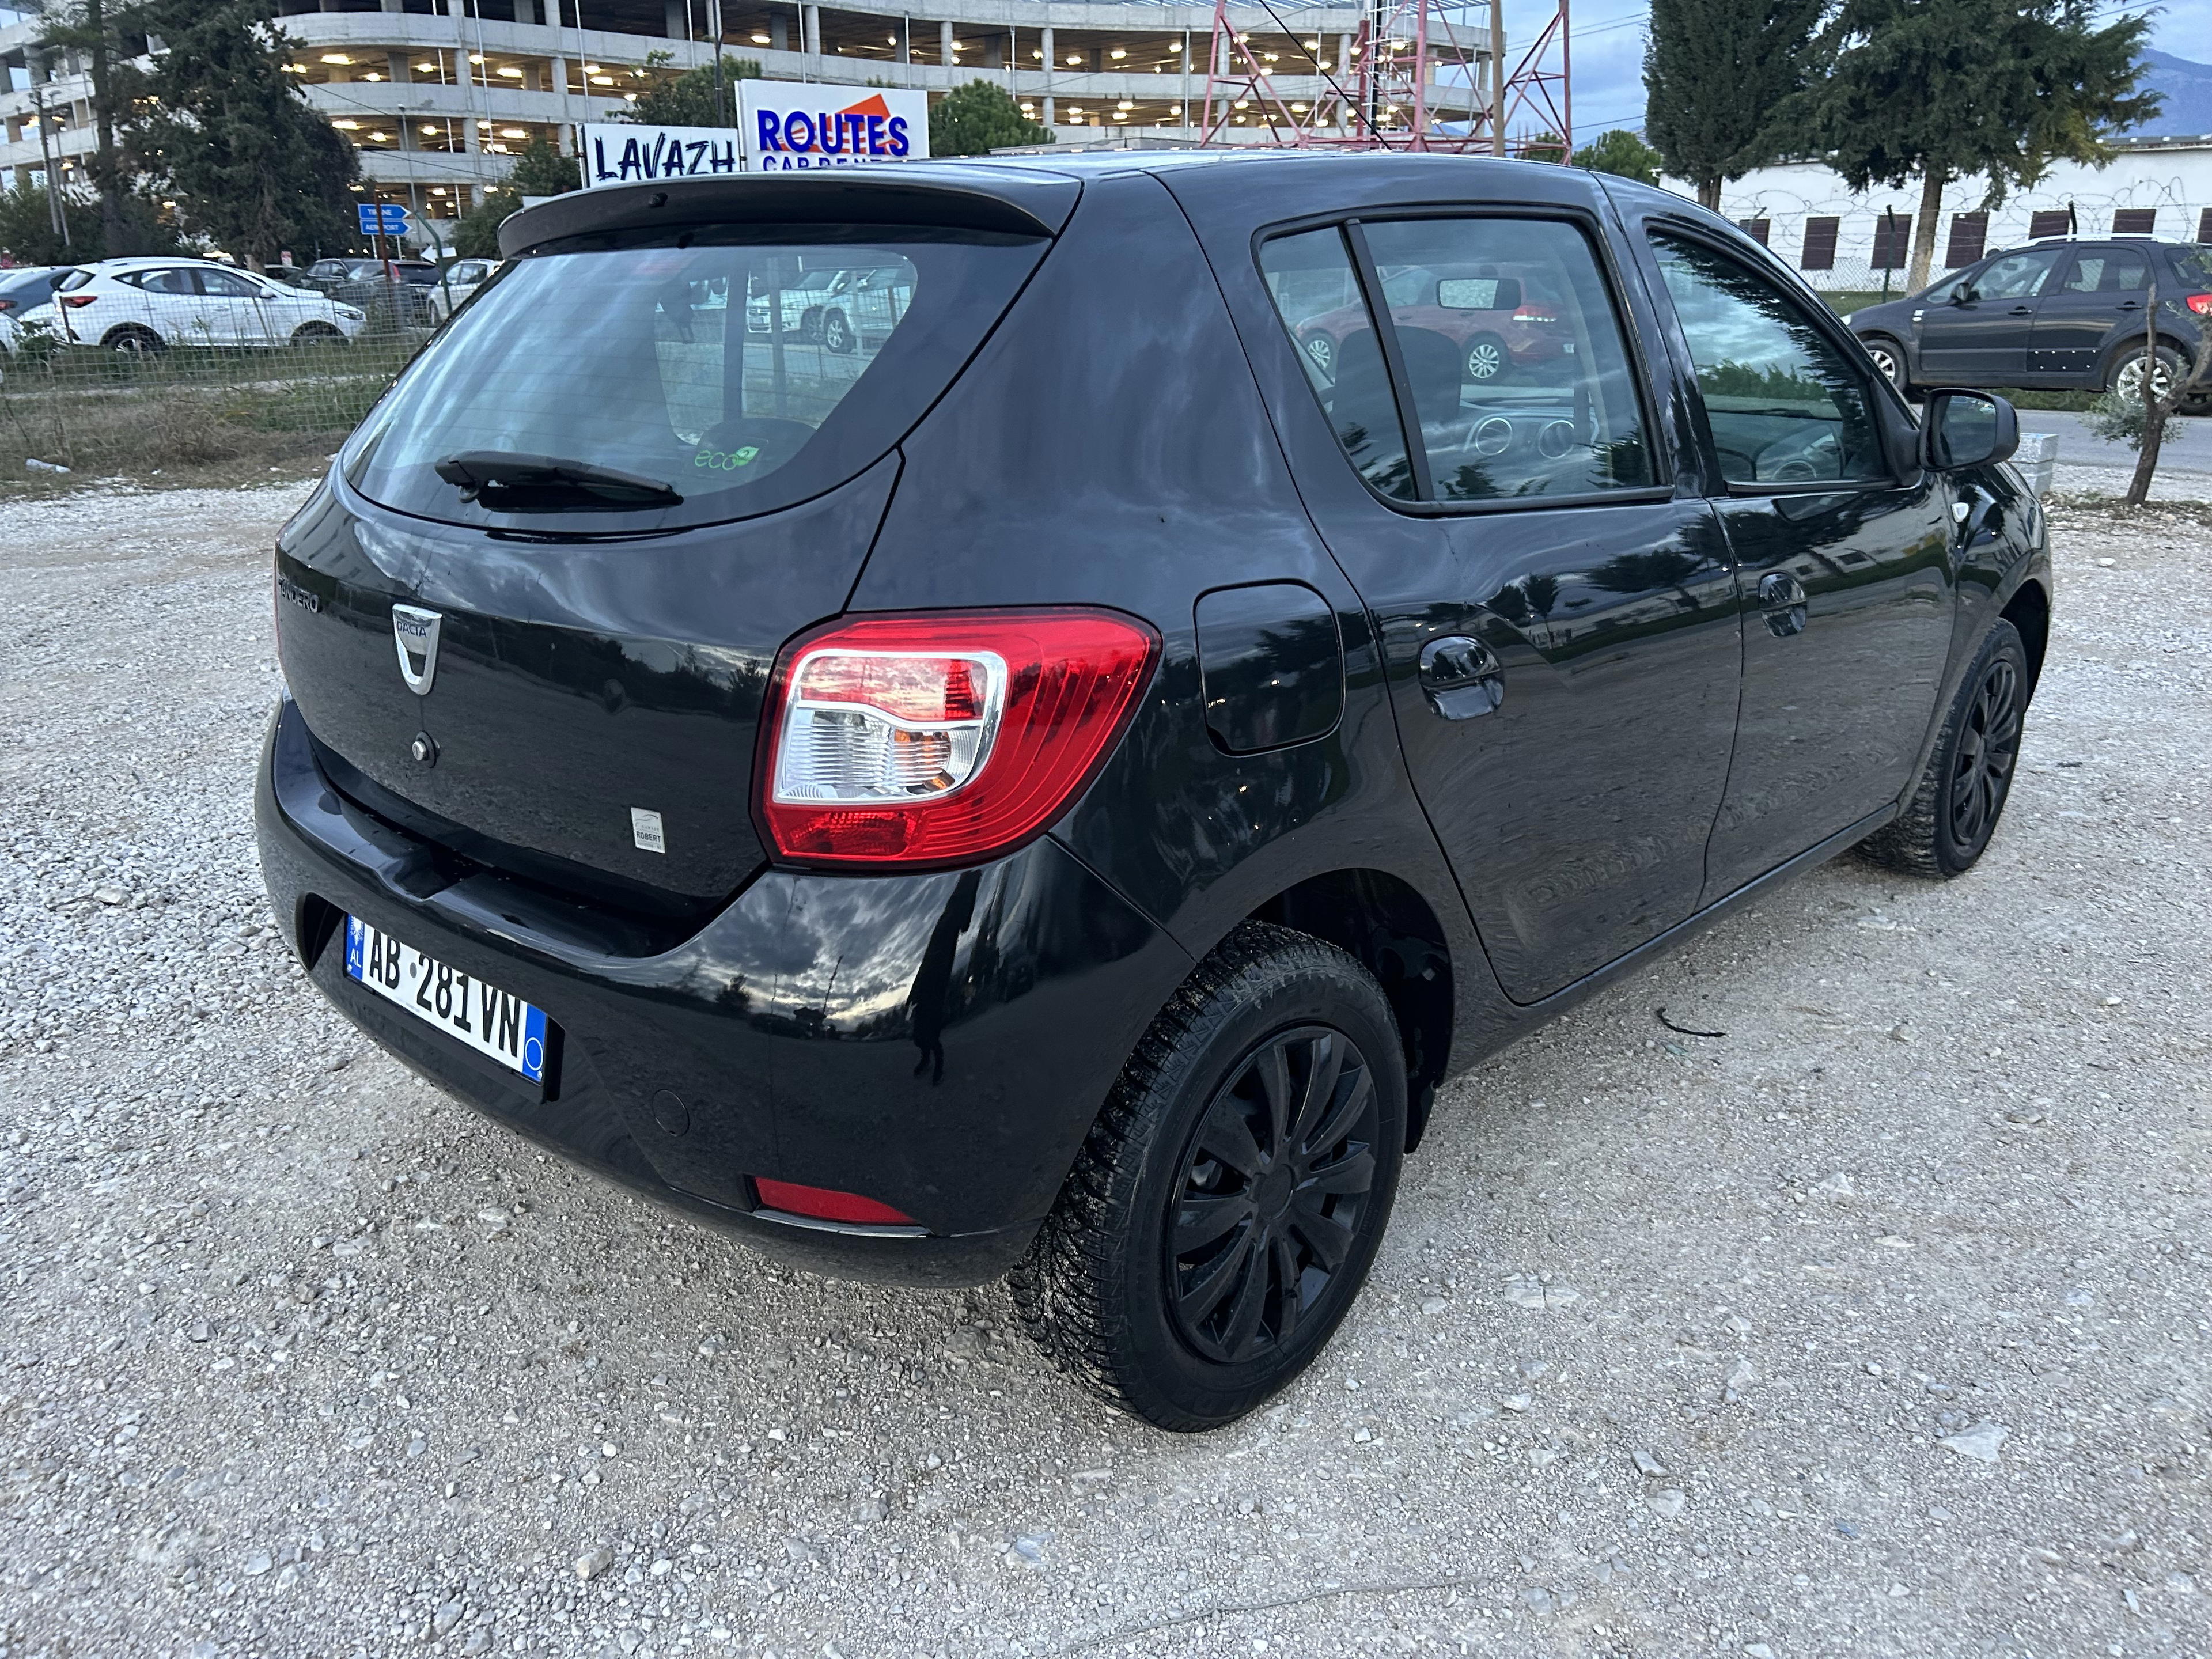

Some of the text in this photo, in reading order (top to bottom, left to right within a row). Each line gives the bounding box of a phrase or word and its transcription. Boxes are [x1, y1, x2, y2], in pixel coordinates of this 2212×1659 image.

[757, 109, 909, 157] ROUTES
[594, 132, 736, 181] LAVAZH
[695, 449, 738, 471] eco
[396, 620, 427, 638] DACIA
[636, 831, 661, 842] ROBERT
[349, 948, 363, 968] AL
[369, 929, 521, 1058] AB 281 VN
